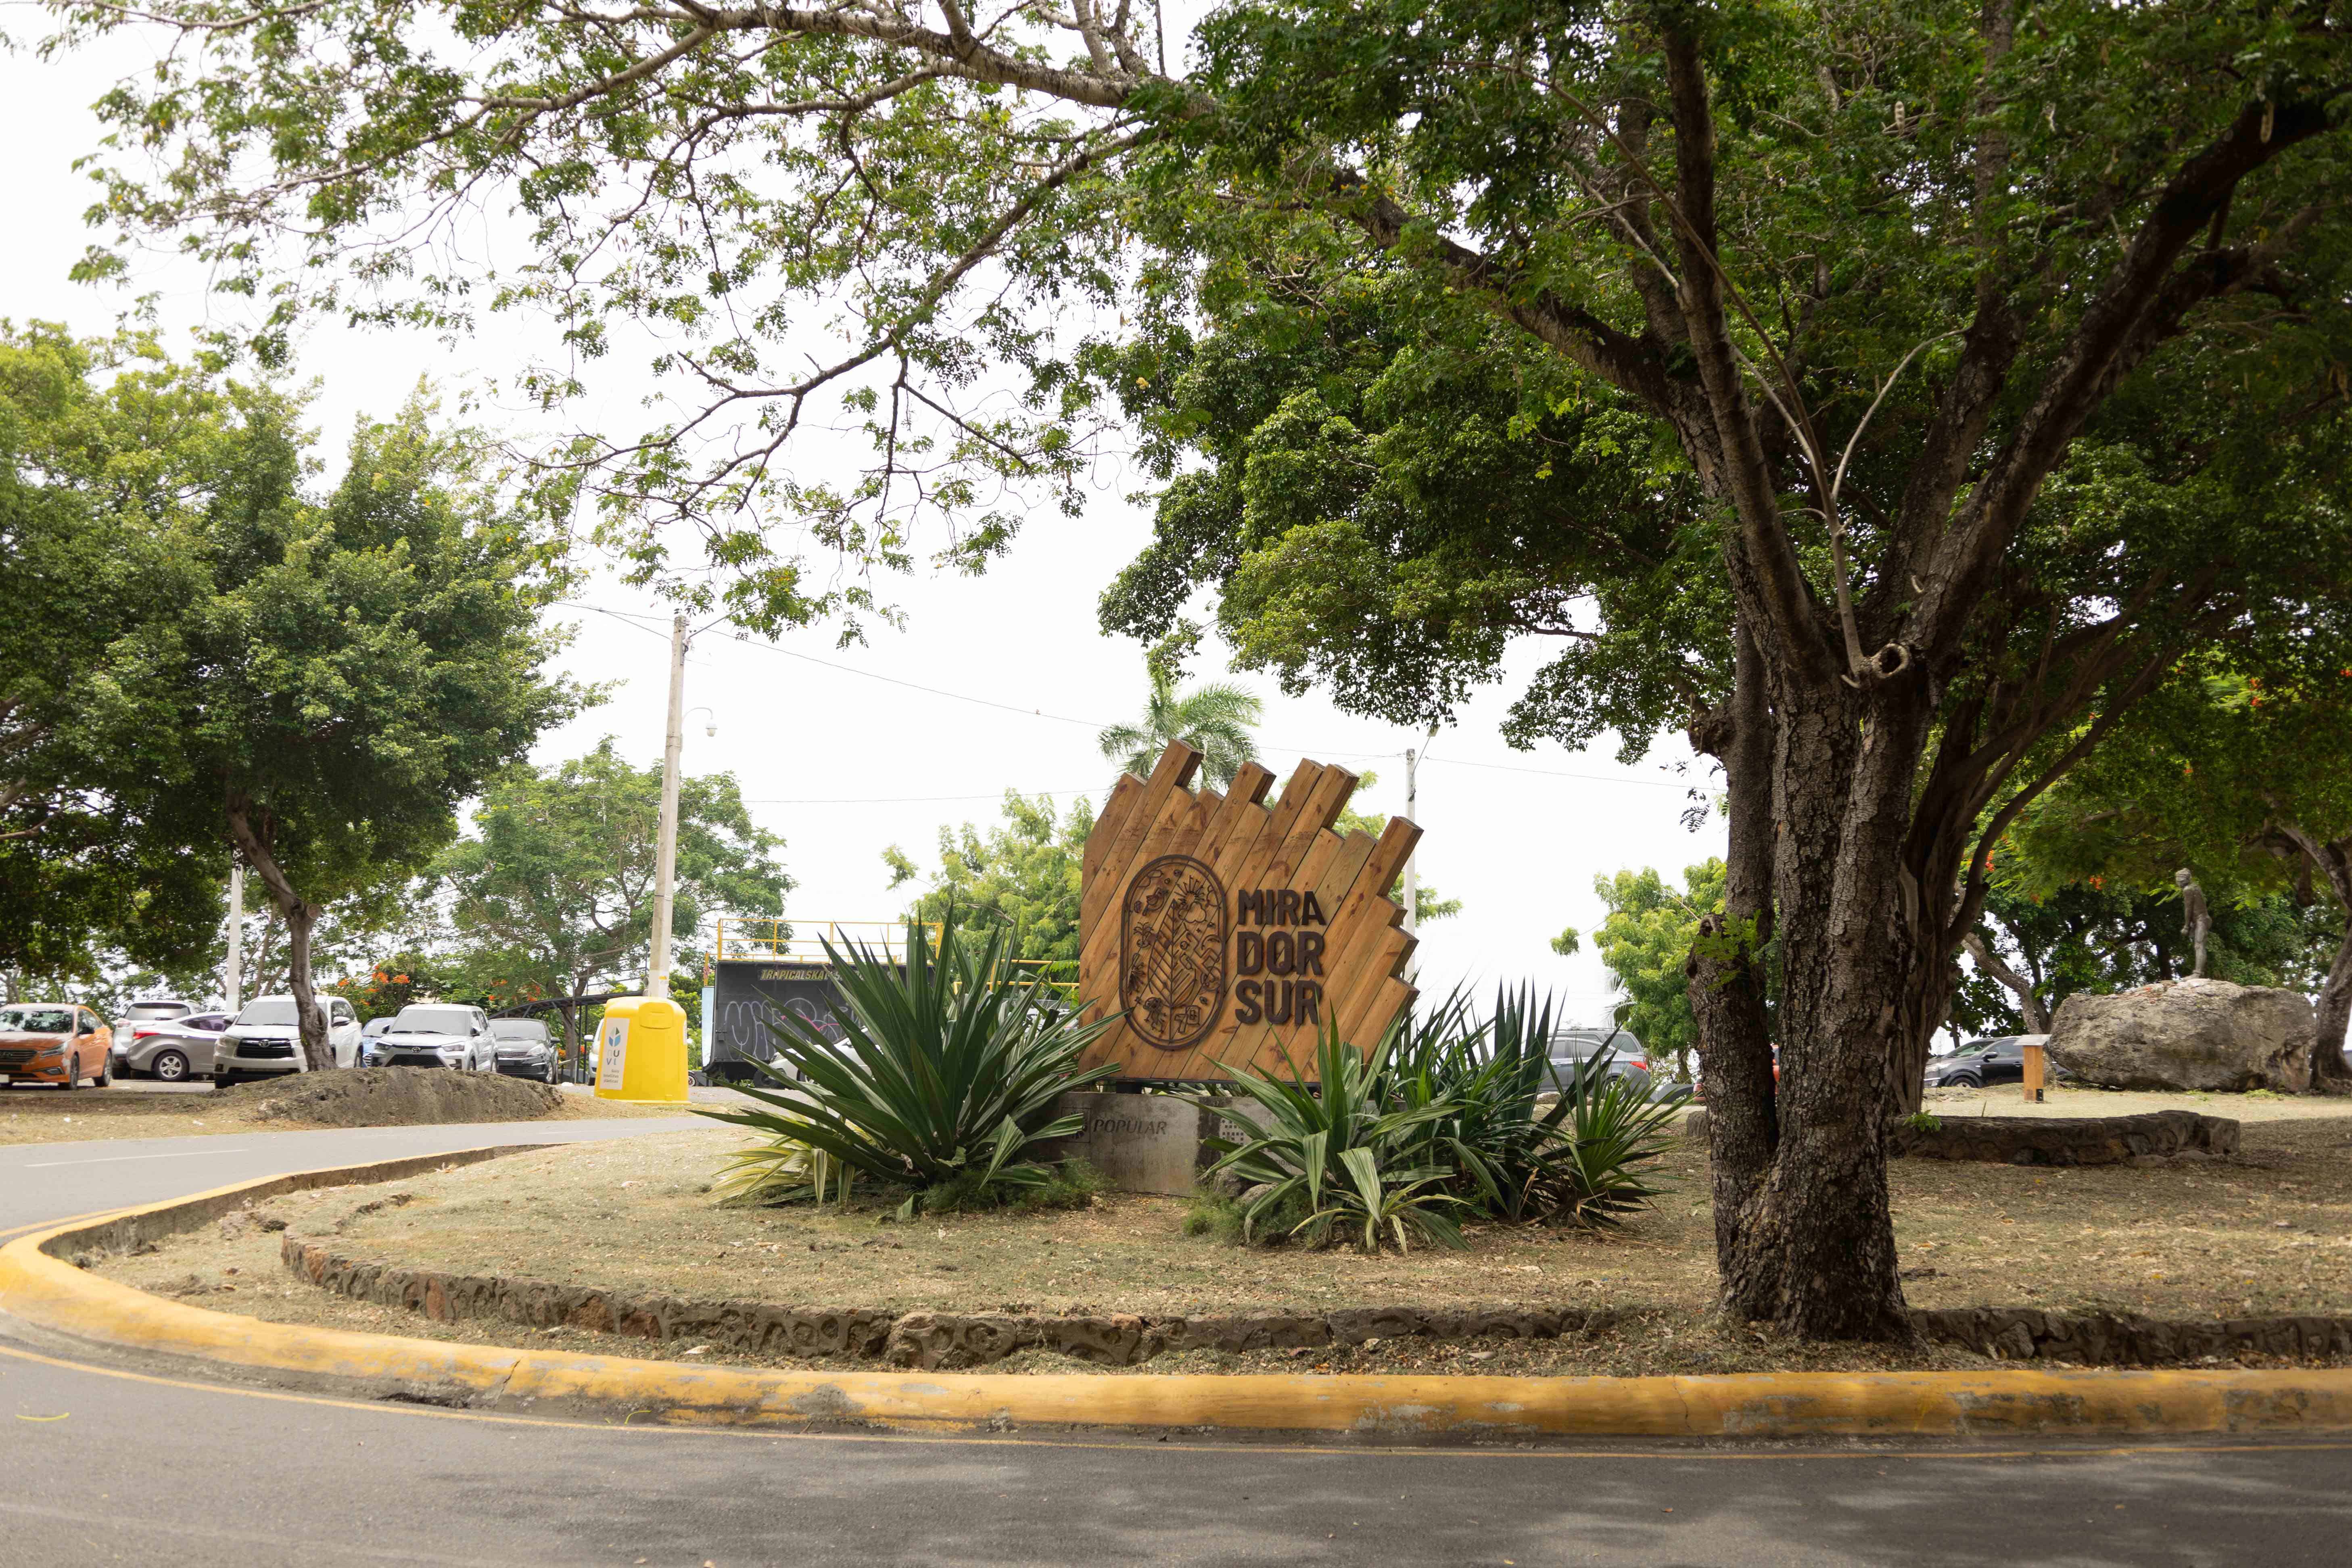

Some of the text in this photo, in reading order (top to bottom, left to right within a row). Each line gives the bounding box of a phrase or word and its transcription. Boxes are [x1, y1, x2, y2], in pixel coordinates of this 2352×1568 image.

[1238, 889, 1326, 925] MIRA
[1237, 931, 1324, 976] DOR
[1235, 979, 1323, 1025] SUR
[1093, 1119, 1167, 1135] POPULAR
